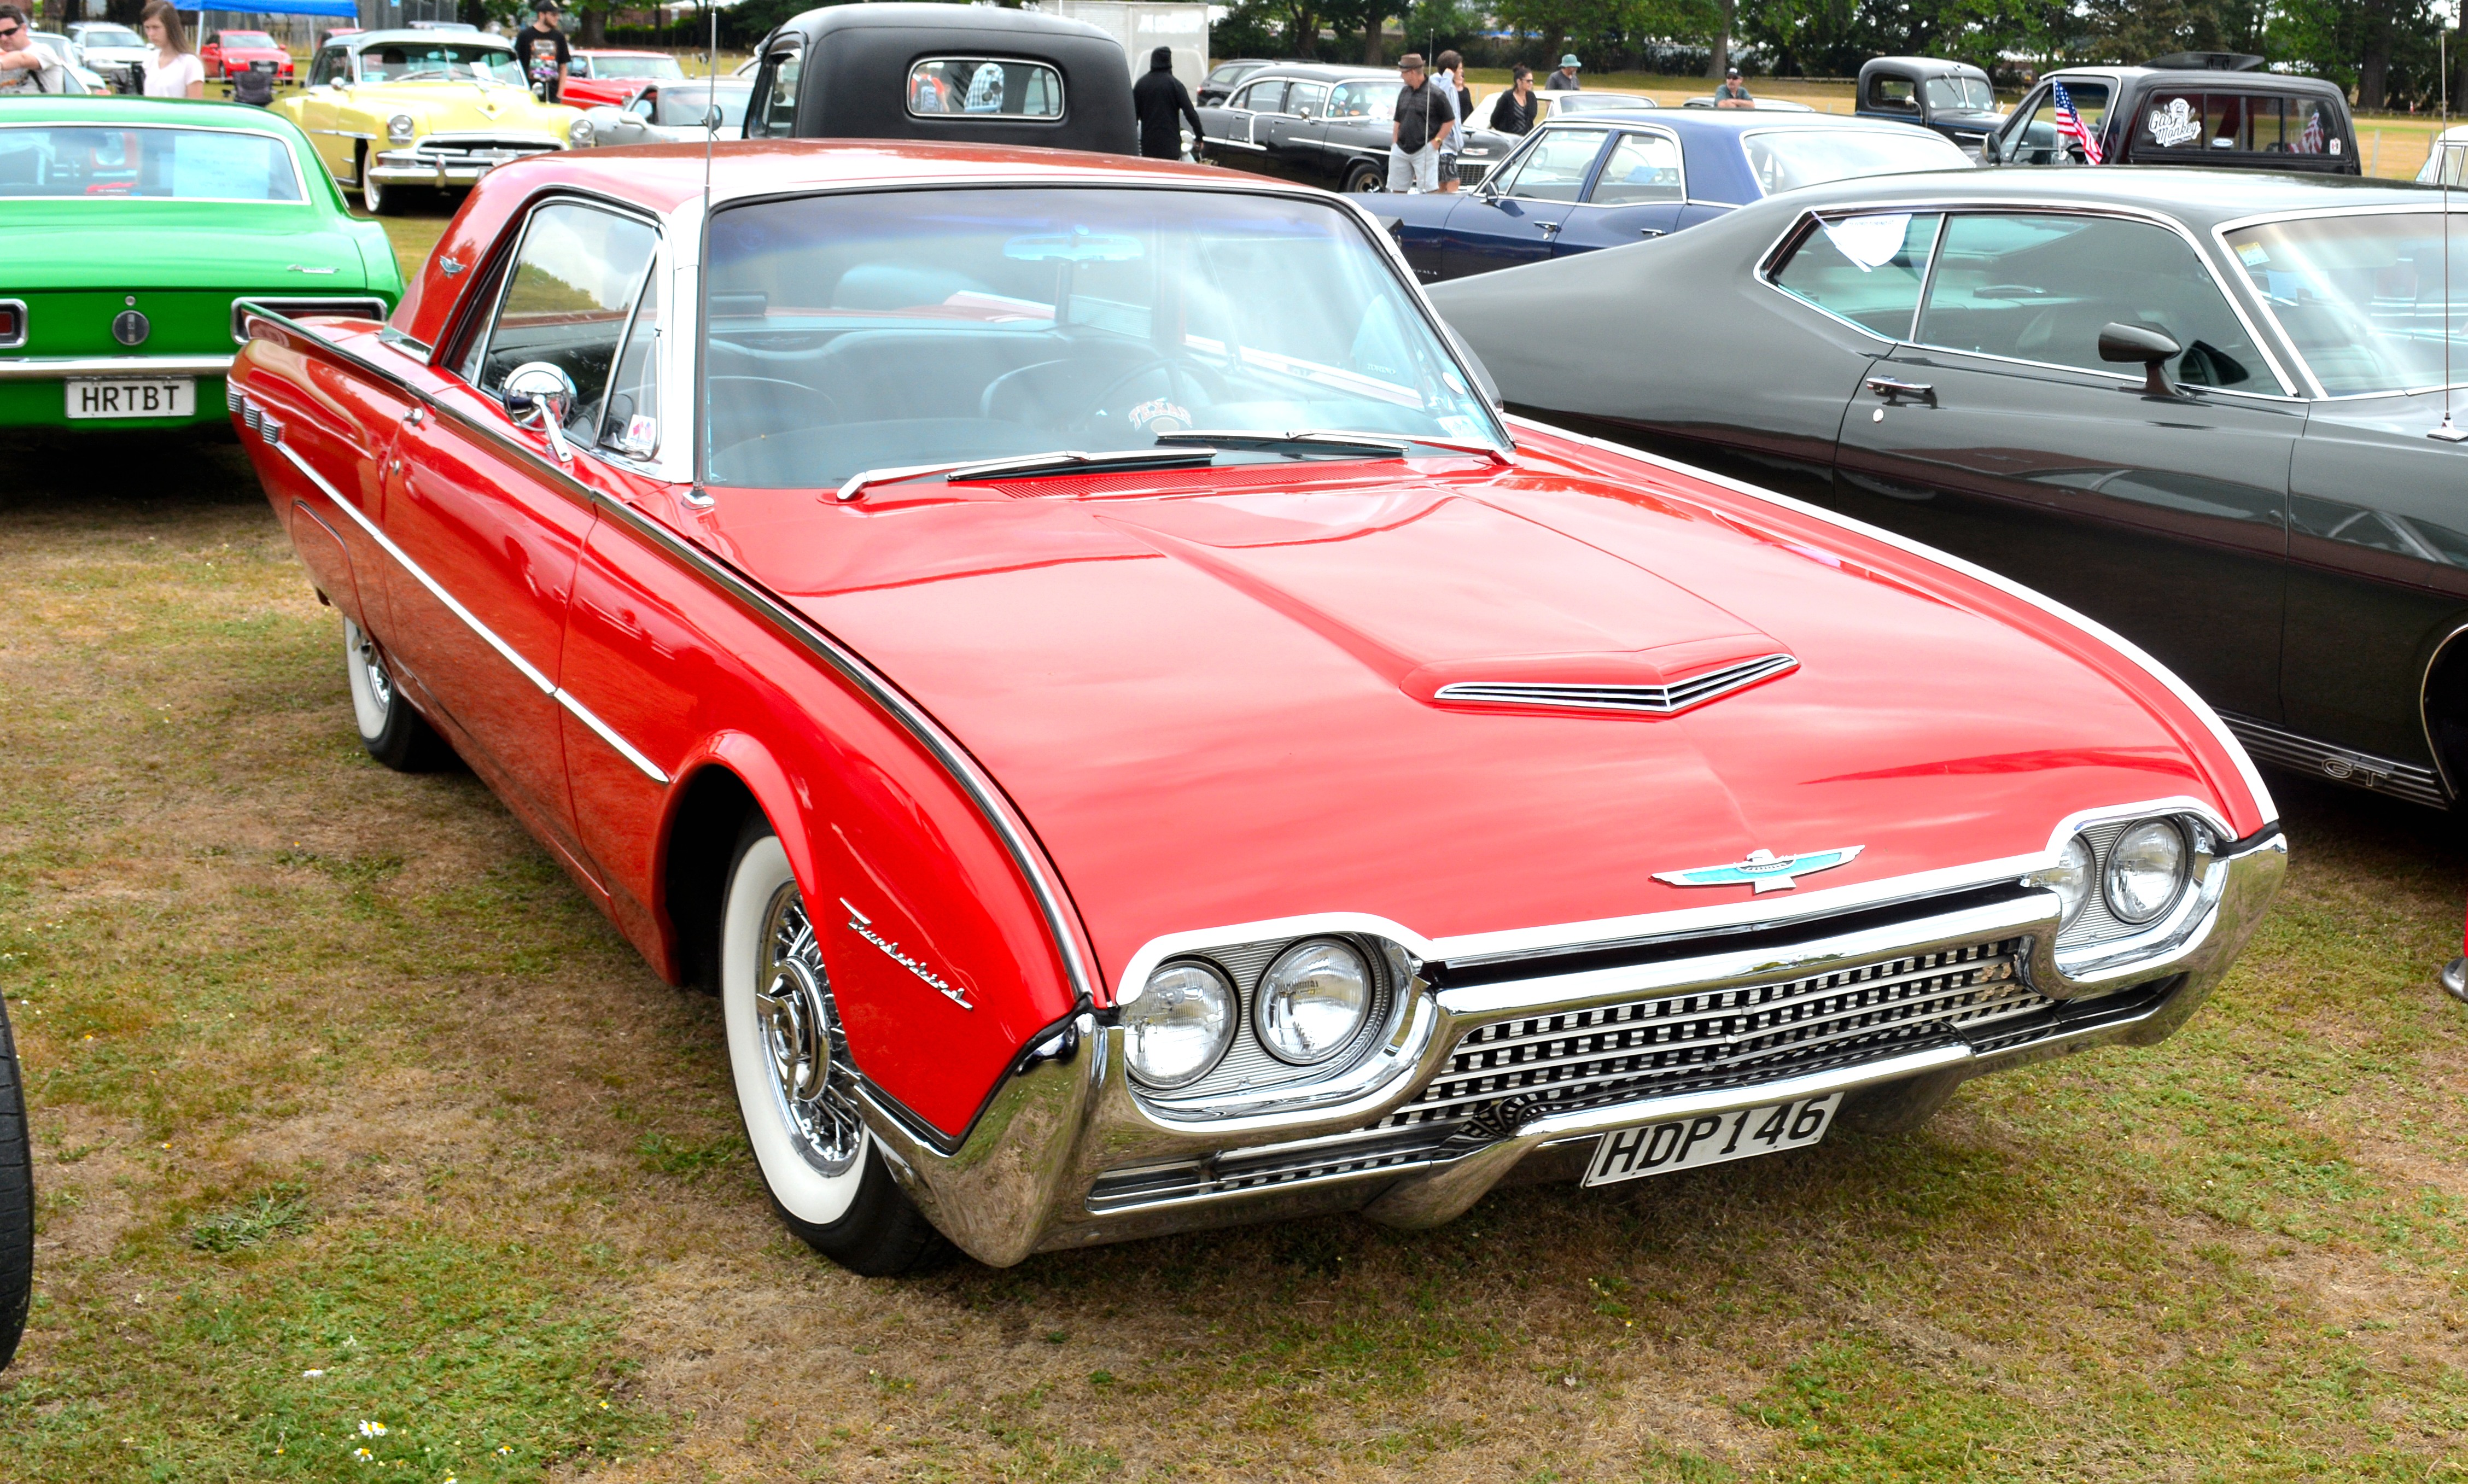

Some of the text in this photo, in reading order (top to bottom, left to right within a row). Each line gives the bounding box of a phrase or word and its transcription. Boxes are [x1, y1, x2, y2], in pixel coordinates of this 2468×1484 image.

[2150, 112, 2178, 130] Gas
[2156, 121, 2198, 143] Monkey
[82, 385, 179, 412] HRTBT
[2321, 758, 2388, 787] GT
[839, 897, 973, 1010] Thunderbird
